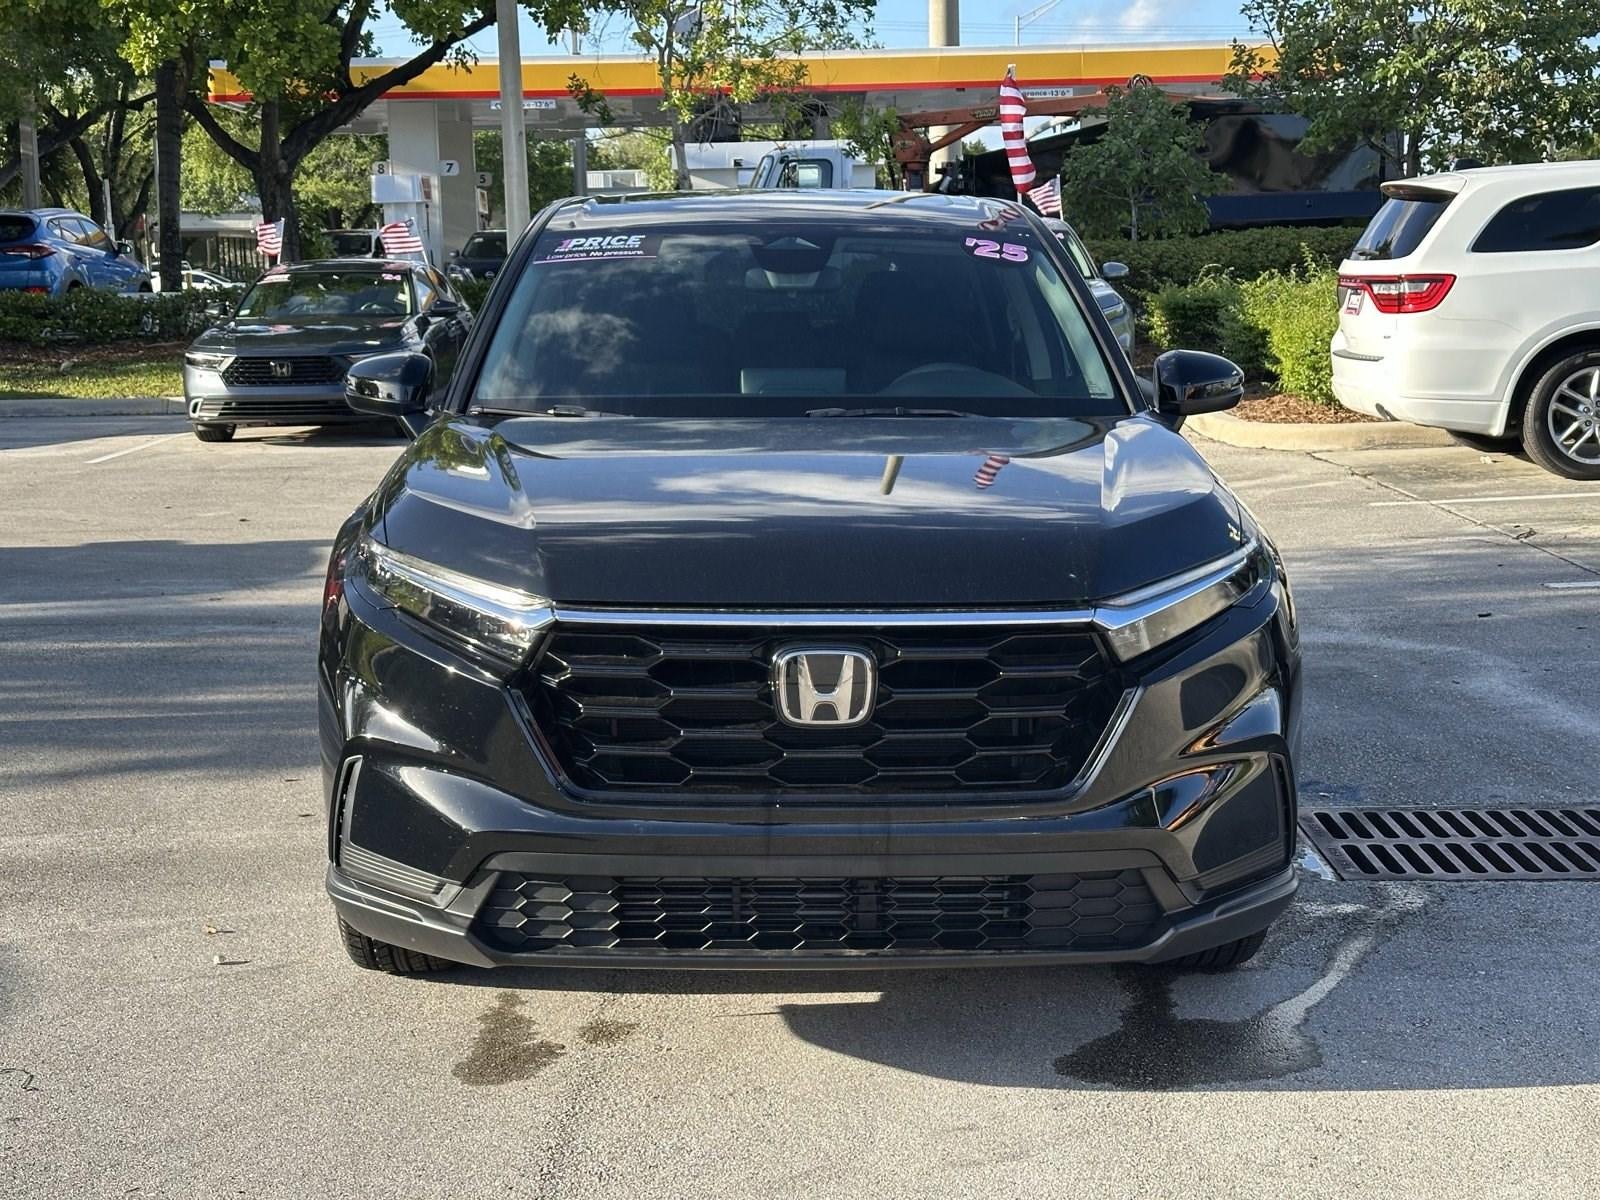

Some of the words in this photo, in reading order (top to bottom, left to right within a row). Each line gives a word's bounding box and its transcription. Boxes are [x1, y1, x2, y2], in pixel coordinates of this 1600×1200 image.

[377, 163, 385, 174] 8
[446, 162, 454, 173] 7
[479, 174, 486, 184] 5
[965, 237, 1029, 262] '25
